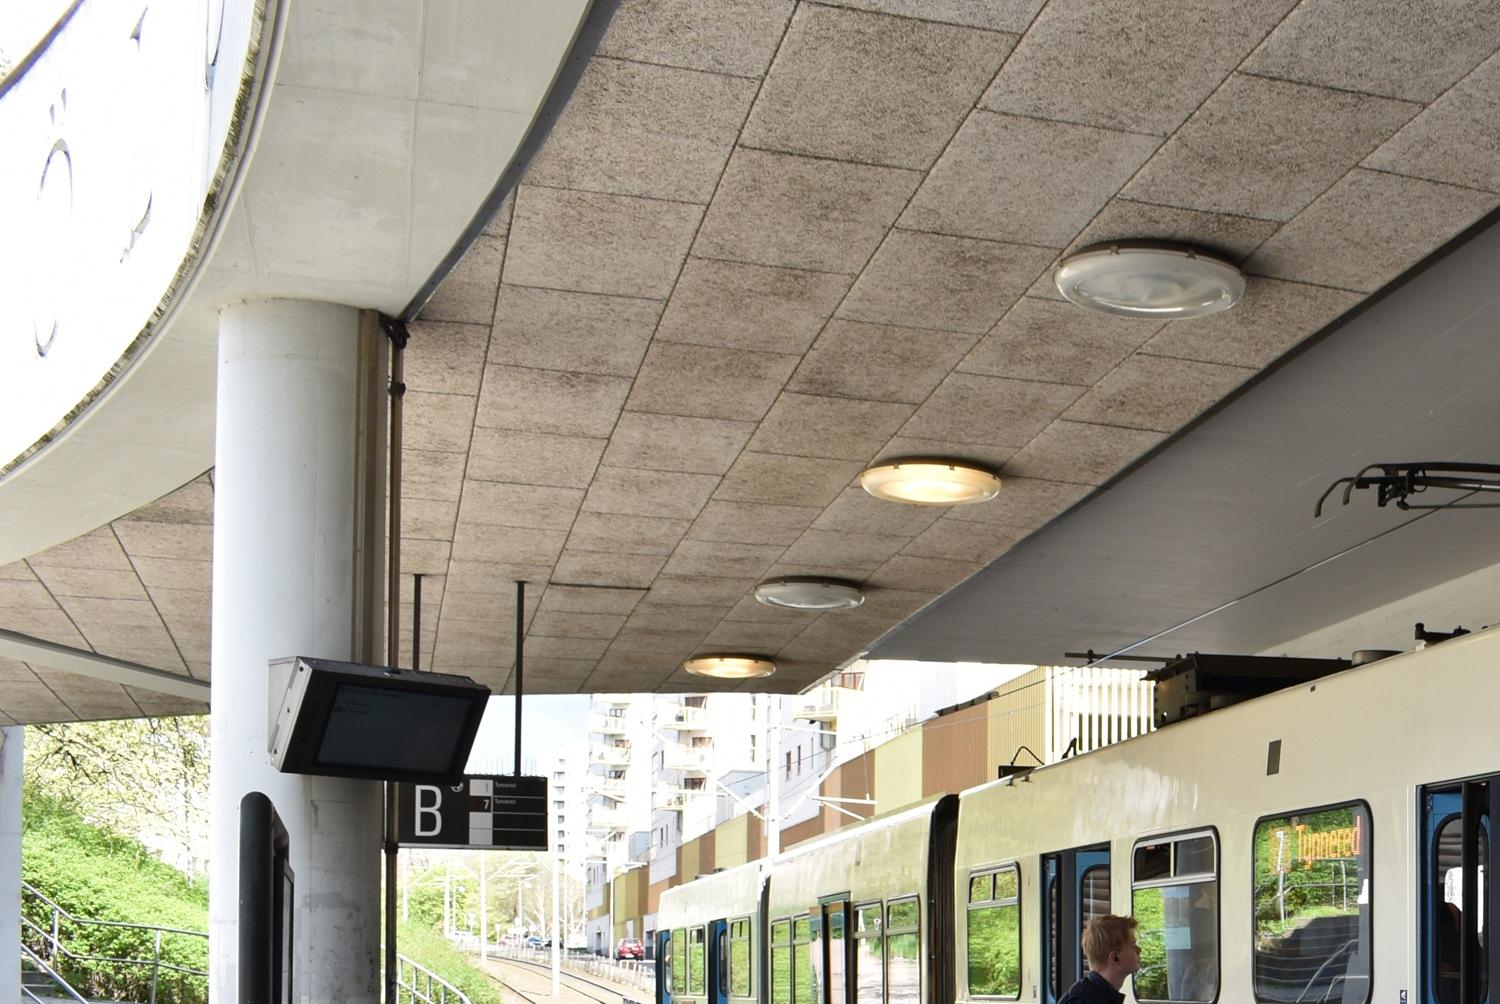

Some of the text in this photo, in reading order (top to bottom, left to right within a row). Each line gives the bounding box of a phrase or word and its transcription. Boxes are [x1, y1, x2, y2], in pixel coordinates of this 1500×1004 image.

[414, 784, 442, 837] B
[483, 800, 490, 810] 7
[1296, 816, 1361, 870] Tynnered
